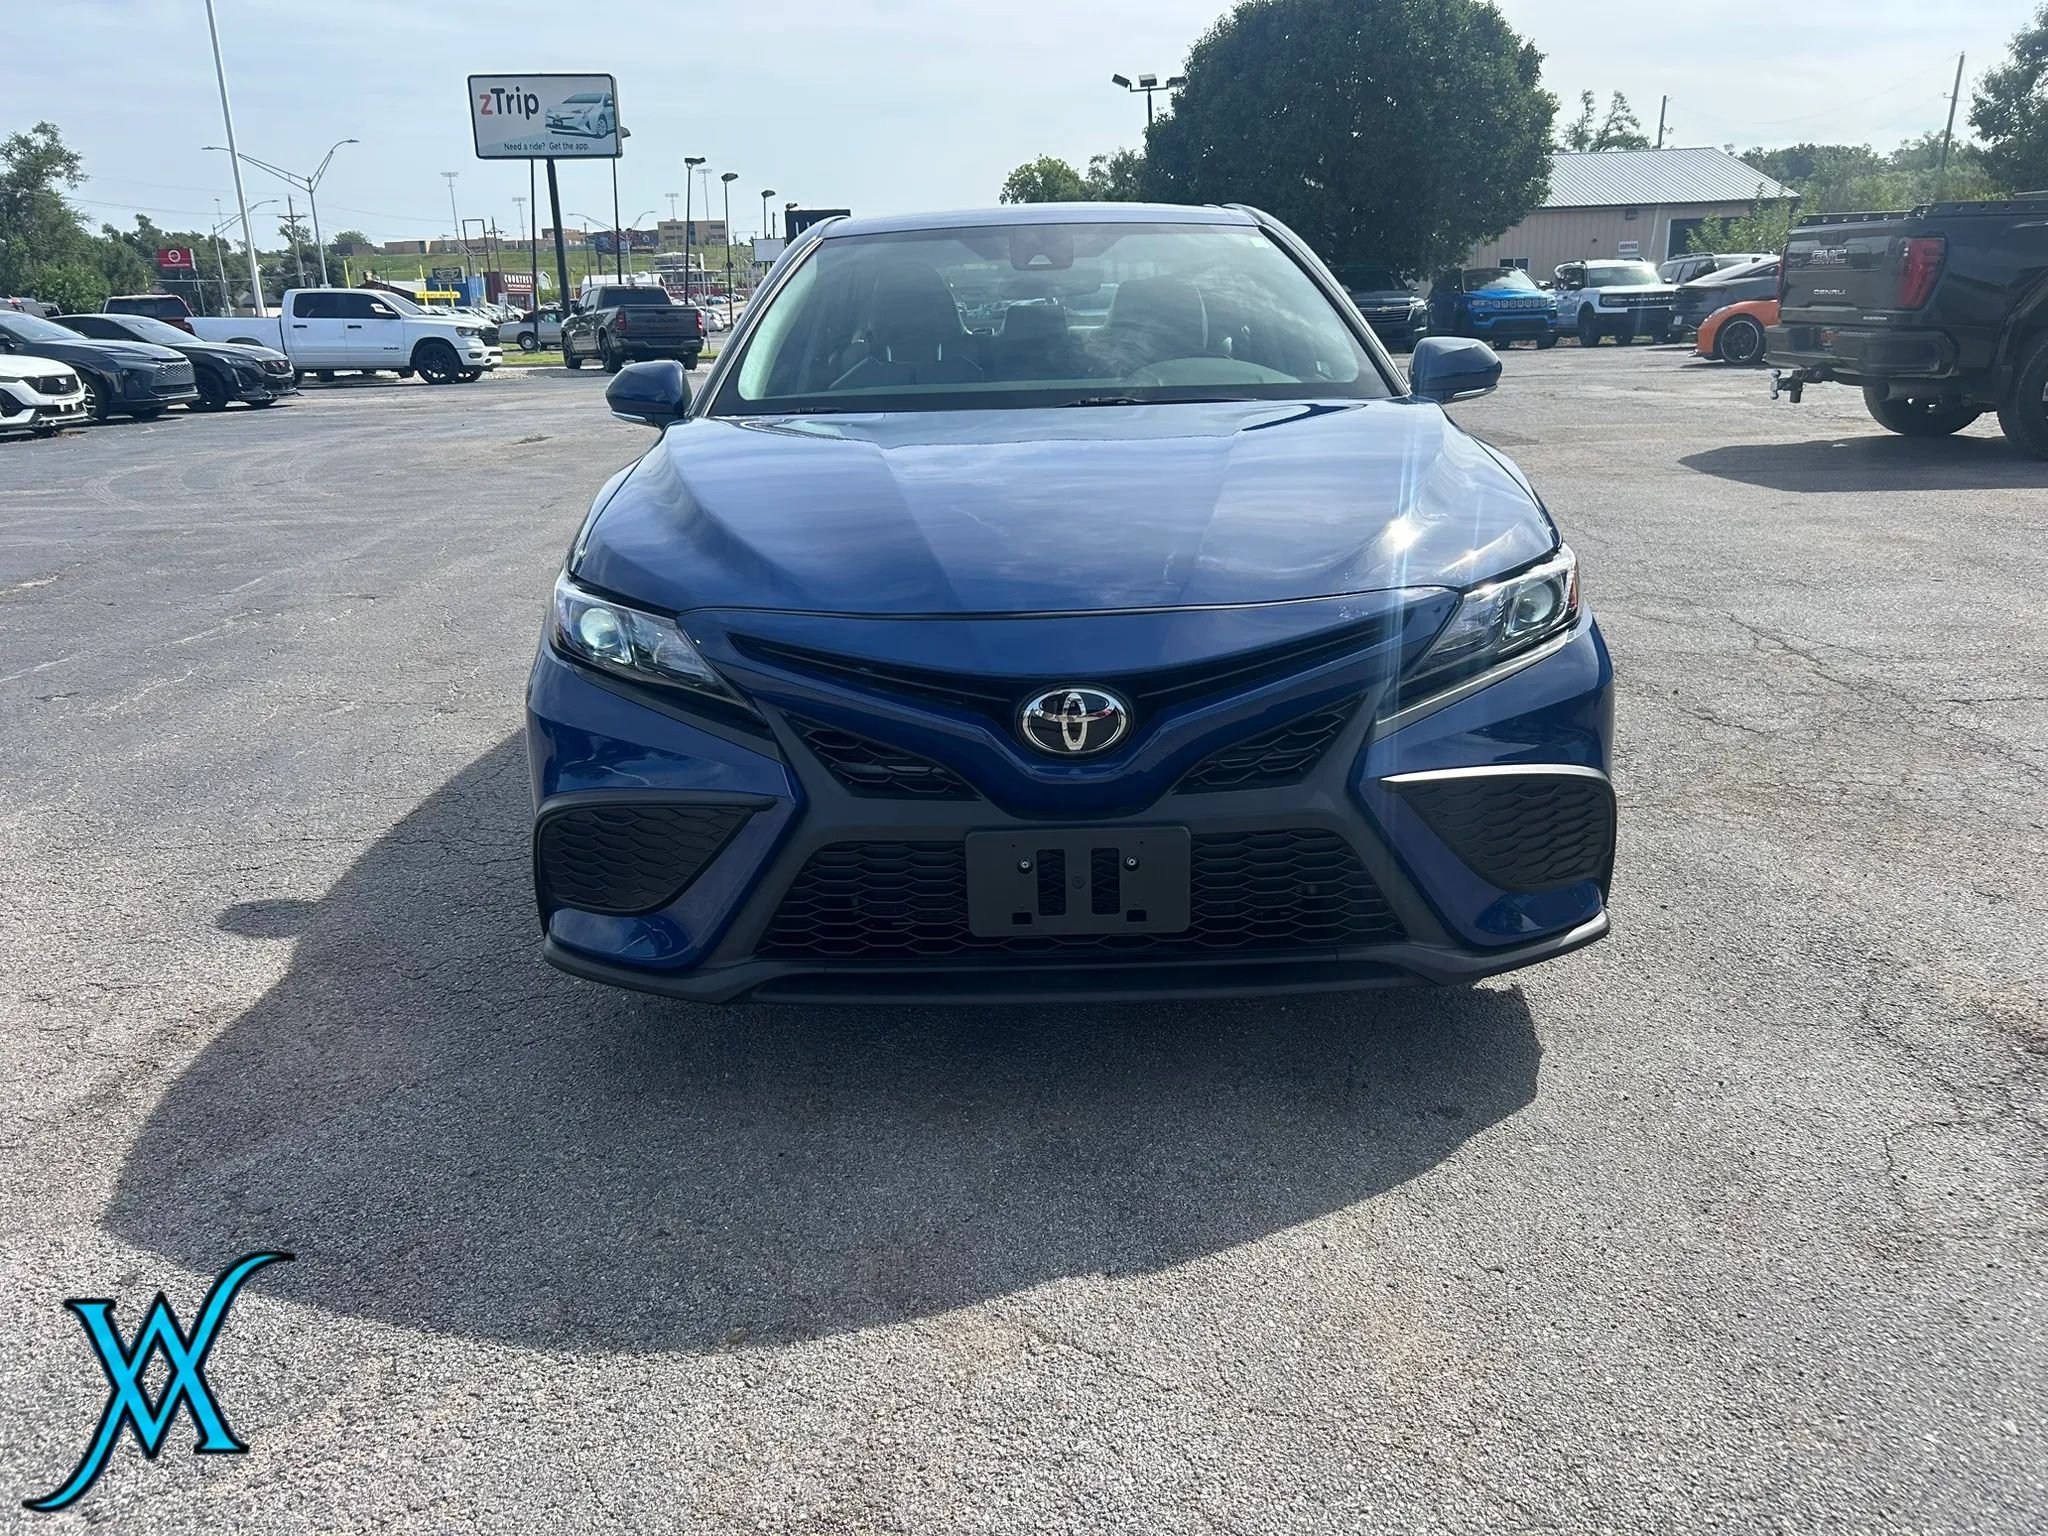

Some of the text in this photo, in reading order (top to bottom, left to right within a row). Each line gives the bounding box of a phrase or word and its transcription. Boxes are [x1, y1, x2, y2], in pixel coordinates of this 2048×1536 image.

[479, 86, 540, 120] zTrip
[503, 142, 590, 152] Need a ride? Get the app.
[1811, 249, 1847, 265] GMC
